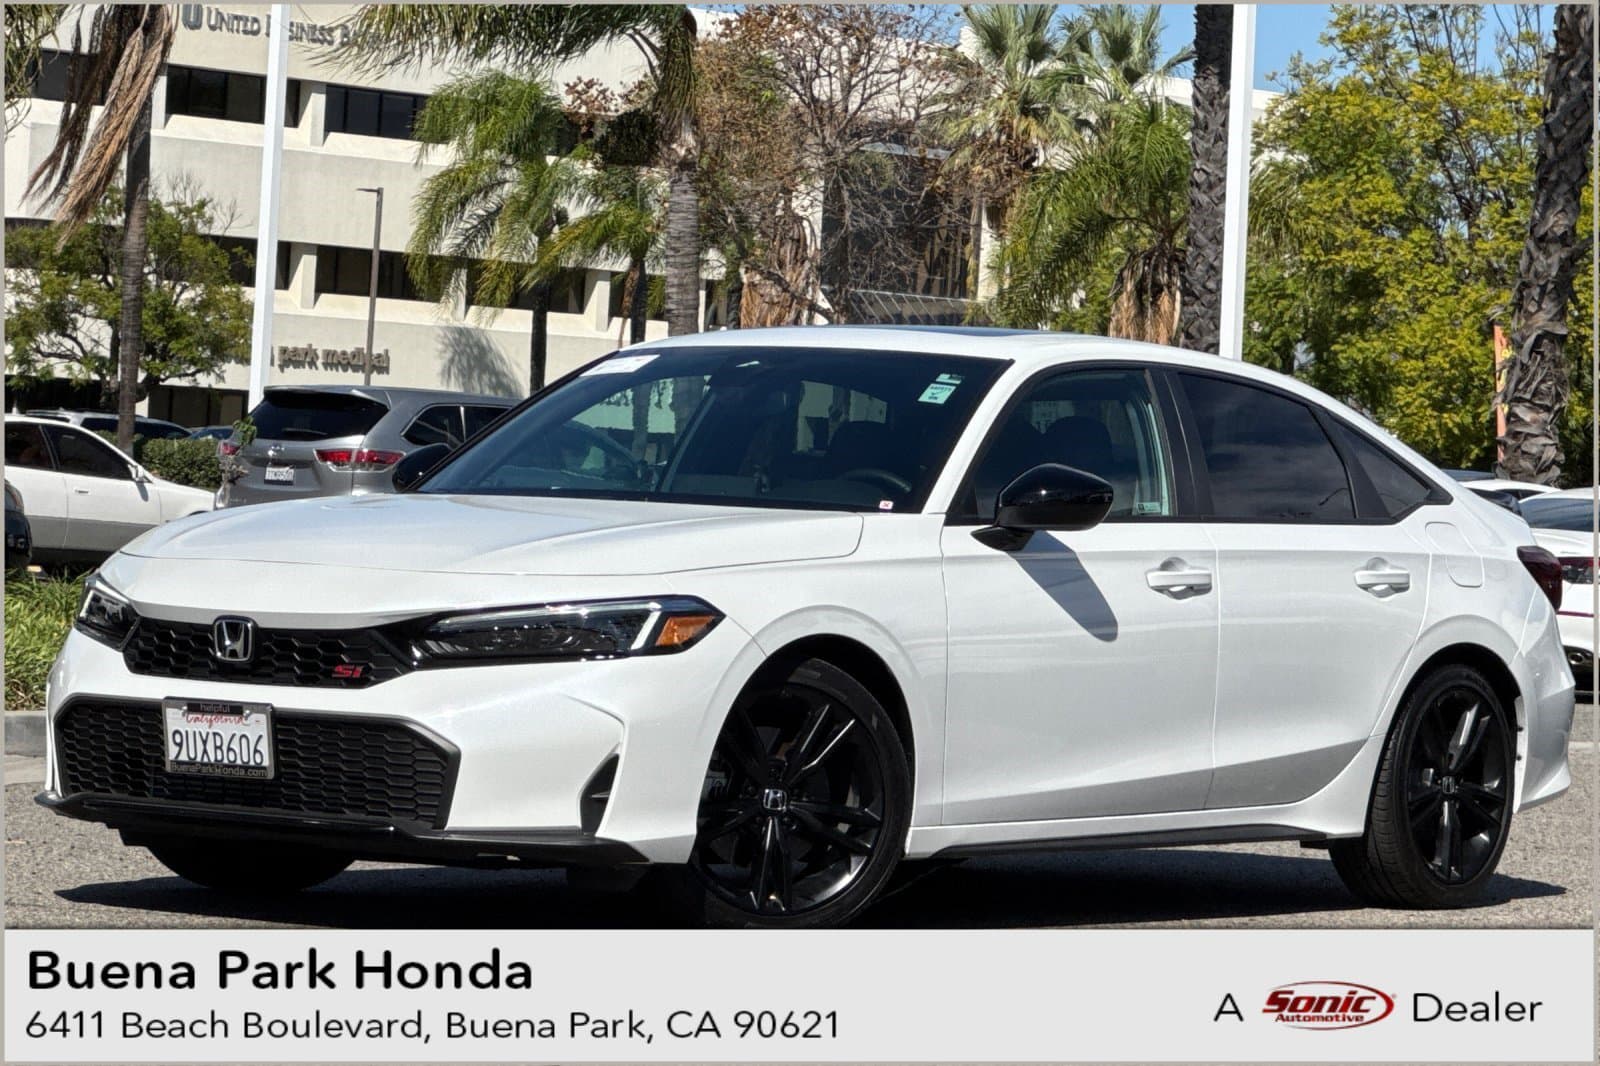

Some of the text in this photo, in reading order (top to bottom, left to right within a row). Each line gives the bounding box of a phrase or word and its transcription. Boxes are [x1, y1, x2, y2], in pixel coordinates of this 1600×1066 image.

[278, 344, 319, 368] park
[322, 347, 389, 371] medial
[172, 729, 264, 766] 9UXB606
[170, 762, 268, 778] BuenaParkHonda.com
